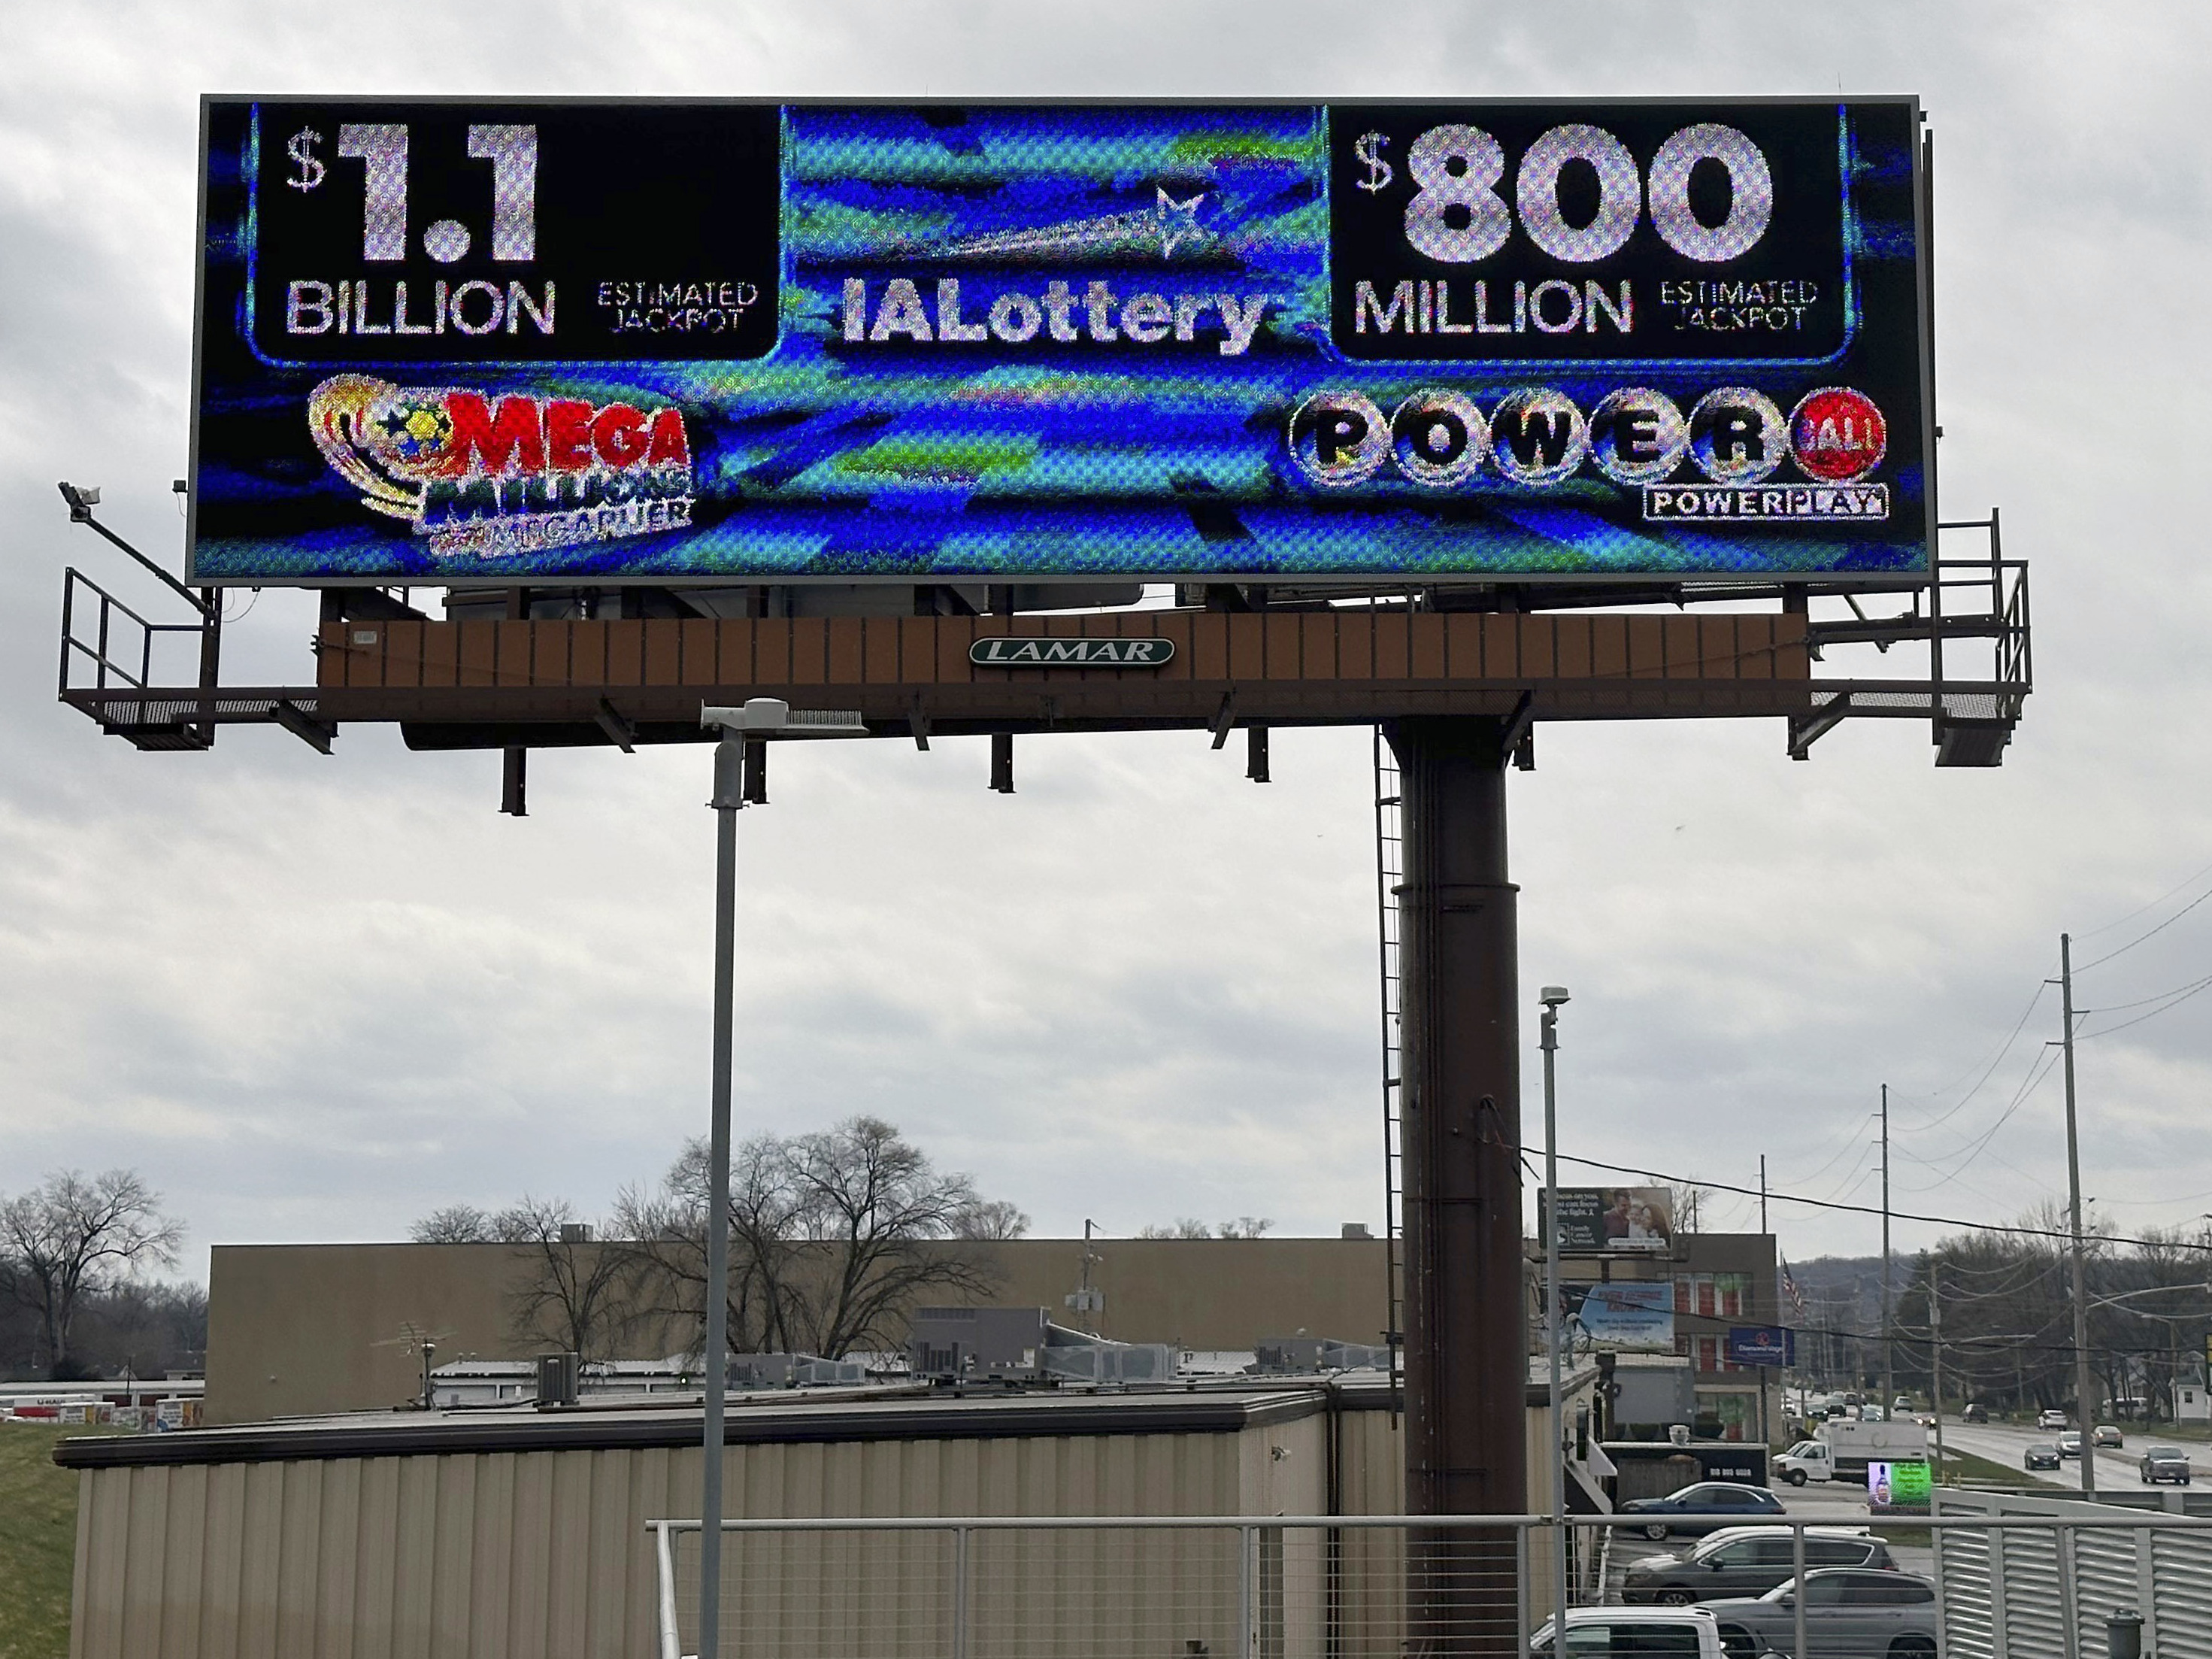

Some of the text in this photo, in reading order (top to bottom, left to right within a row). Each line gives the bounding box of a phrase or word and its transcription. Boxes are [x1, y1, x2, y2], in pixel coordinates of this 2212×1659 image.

[597, 281, 758, 306] ESTIMATED
[1659, 281, 1818, 305] ESTIMATED
[286, 280, 556, 335] BILLION
[842, 277, 1268, 356] IALottery
[1354, 280, 1635, 334] MILLION
[1674, 306, 1807, 331] JACKPOT
[608, 308, 744, 333] JACKPOT
[441, 390, 689, 481] MEGA
[986, 641, 1153, 660] LAMAR
